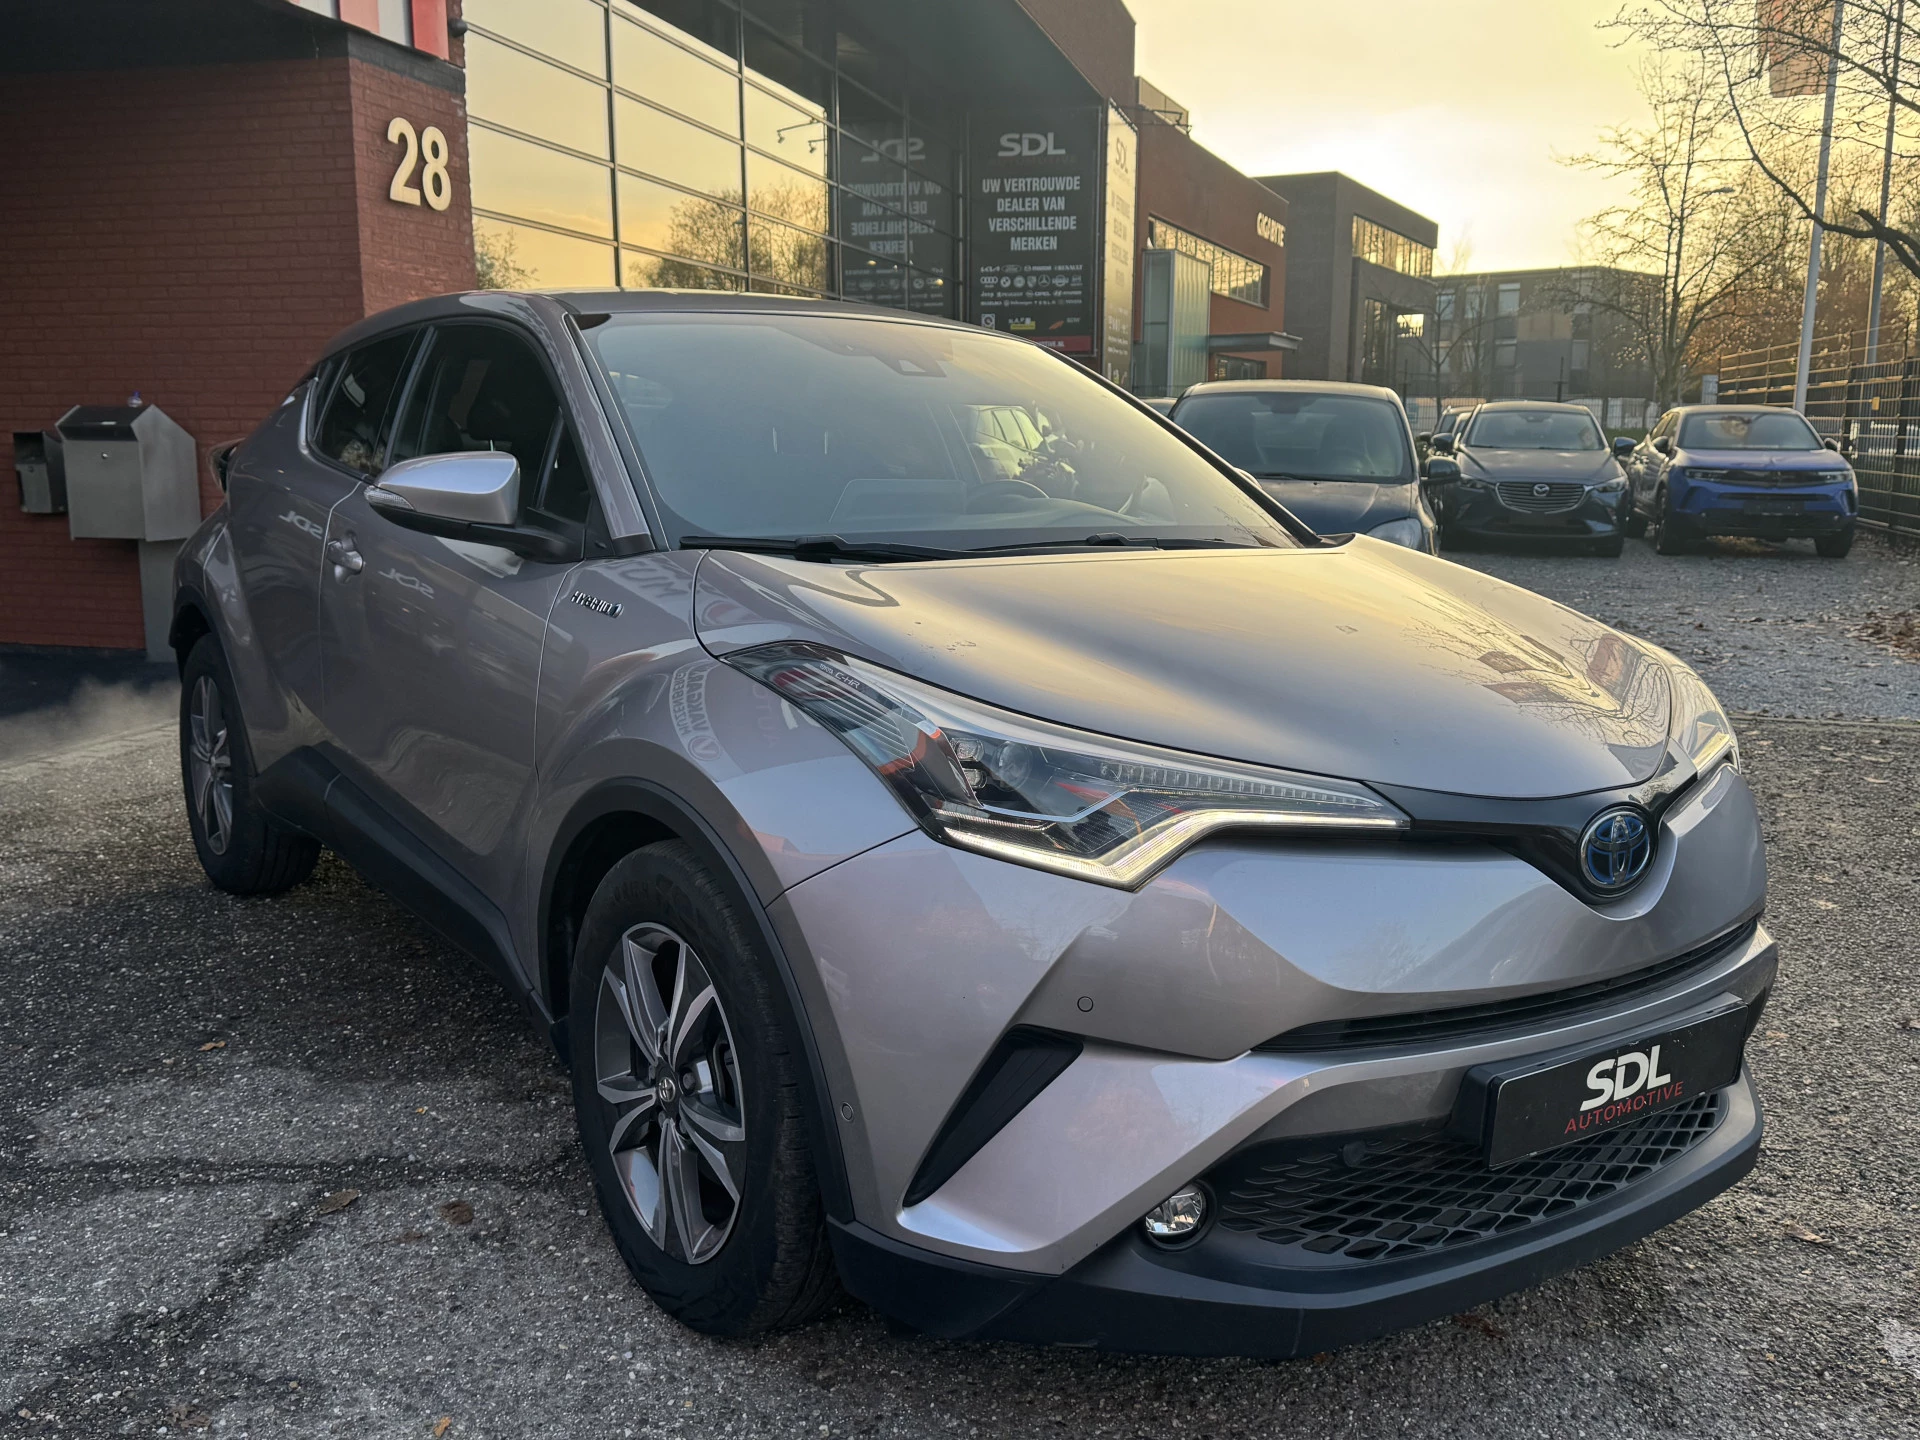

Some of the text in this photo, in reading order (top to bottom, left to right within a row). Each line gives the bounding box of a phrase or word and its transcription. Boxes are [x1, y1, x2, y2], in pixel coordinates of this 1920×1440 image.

[998, 132, 1066, 157] SDL
[387, 117, 452, 211] 28
[982, 176, 1080, 193] UW VERTROUWDE
[997, 196, 1065, 212] DEALER VAN
[988, 216, 1077, 232] VERSCHILLENDE
[1010, 236, 1057, 251] MERKEN
[571, 590, 613, 615] HYBRID
[835, 672, 861, 689] C-HR
[1579, 1044, 1671, 1112] SDL
[1564, 1081, 1684, 1134] AUTOMOTIVE
